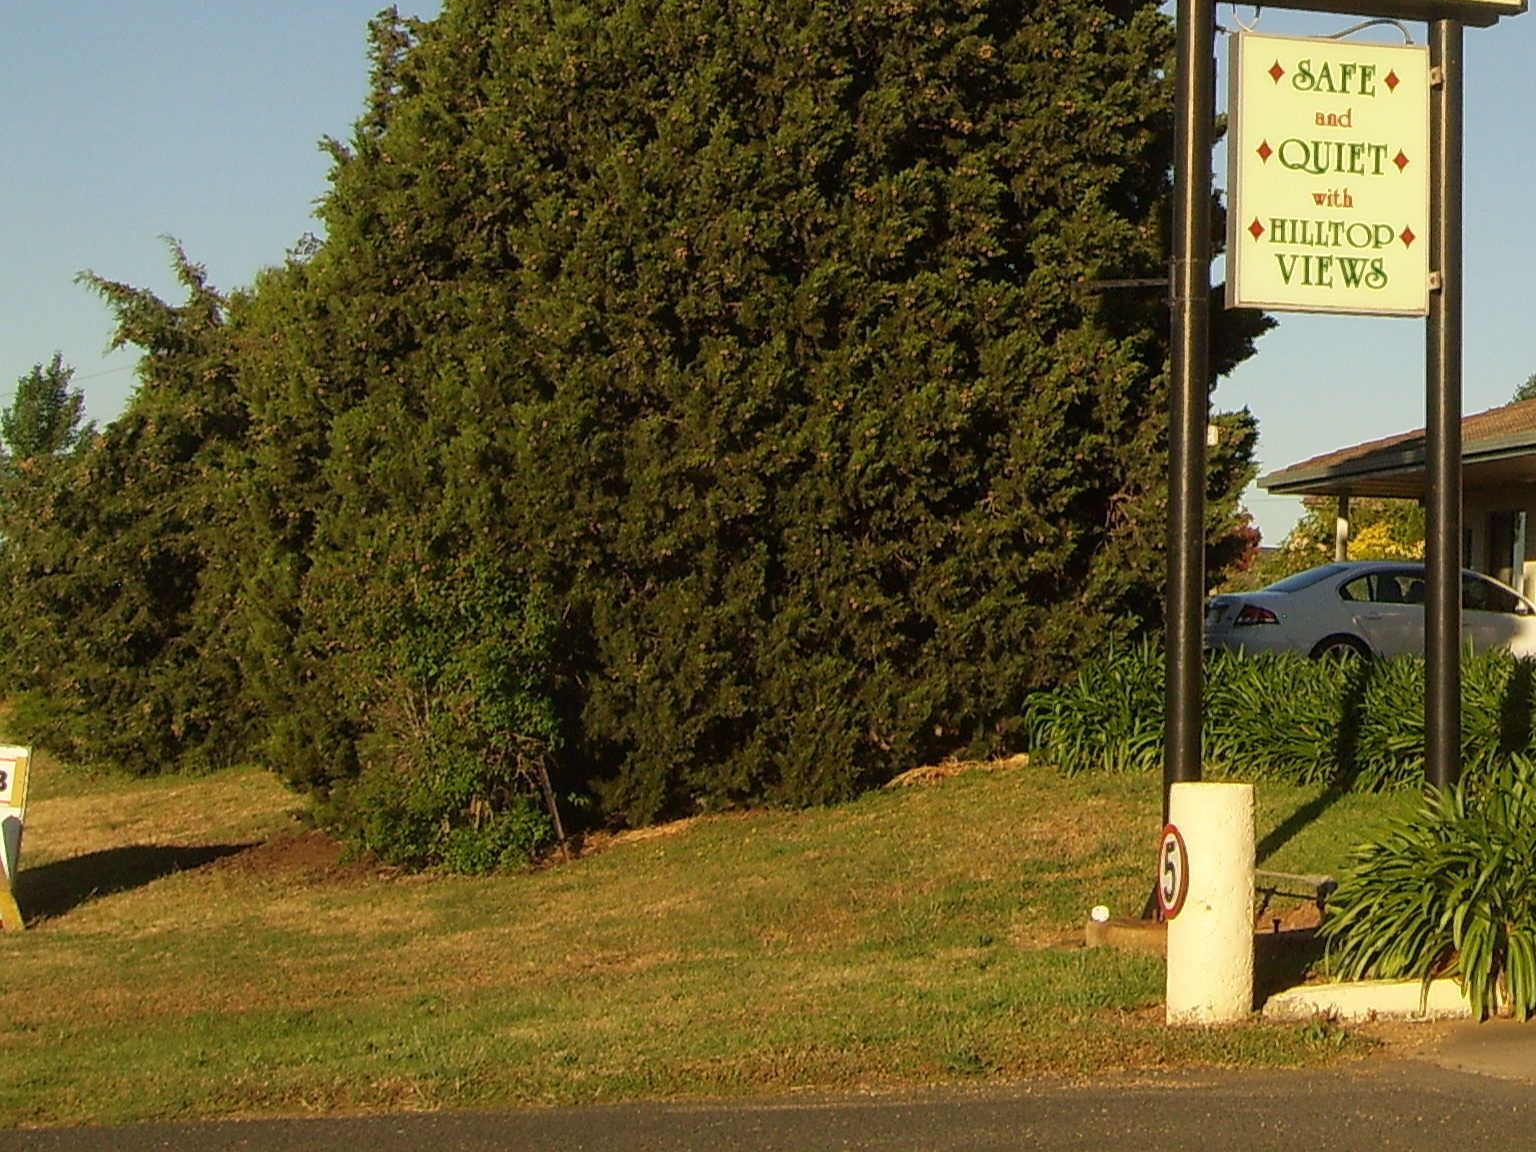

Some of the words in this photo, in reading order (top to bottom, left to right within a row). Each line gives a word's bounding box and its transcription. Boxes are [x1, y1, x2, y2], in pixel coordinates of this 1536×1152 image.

[1292, 59, 1376, 97] SAFE
[1315, 108, 1352, 128] and
[1278, 138, 1388, 176] QUIET
[1312, 187, 1353, 208] with
[1268, 217, 1395, 249] HILLTOP
[1274, 253, 1388, 289] VIEWS
[1164, 841, 1176, 902] 5
